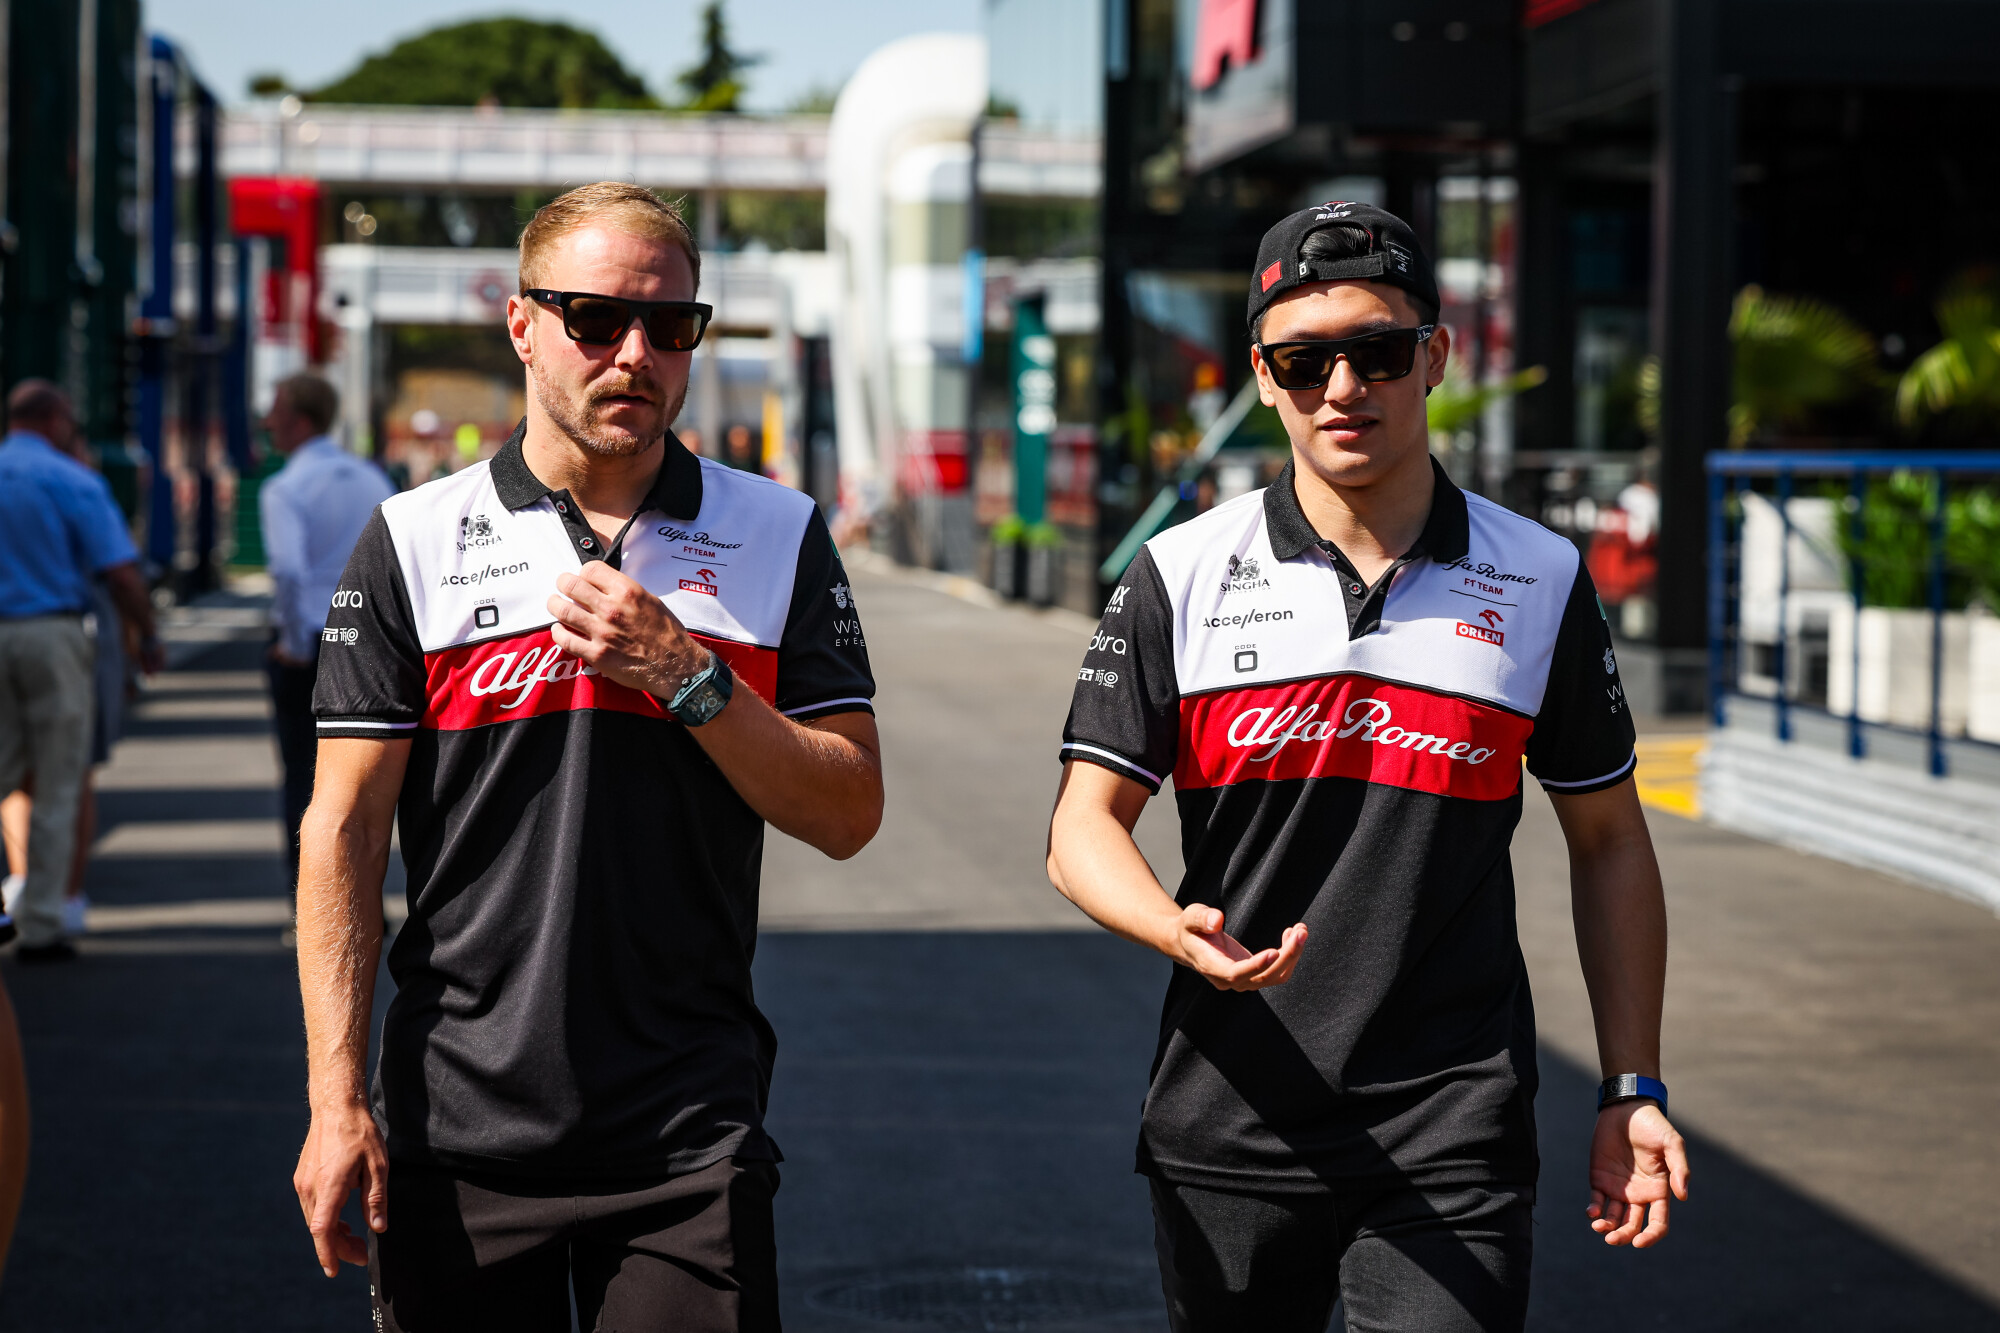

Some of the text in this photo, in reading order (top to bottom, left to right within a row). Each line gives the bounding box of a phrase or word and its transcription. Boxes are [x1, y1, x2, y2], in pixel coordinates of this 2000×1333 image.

[456, 535, 502, 551] SINGHA
[657, 526, 743, 549] Alfa Romeo
[694, 548, 716, 558] TEAM
[1475, 563, 1538, 584] Romeo
[680, 581, 715, 595] ORLEN
[1220, 578, 1270, 592] SINGHA
[1477, 581, 1503, 595] TEAM
[1458, 624, 1501, 644] ORLEN
[470, 644, 582, 709] Alfa
[1227, 698, 1496, 765] Alfa Romeo
